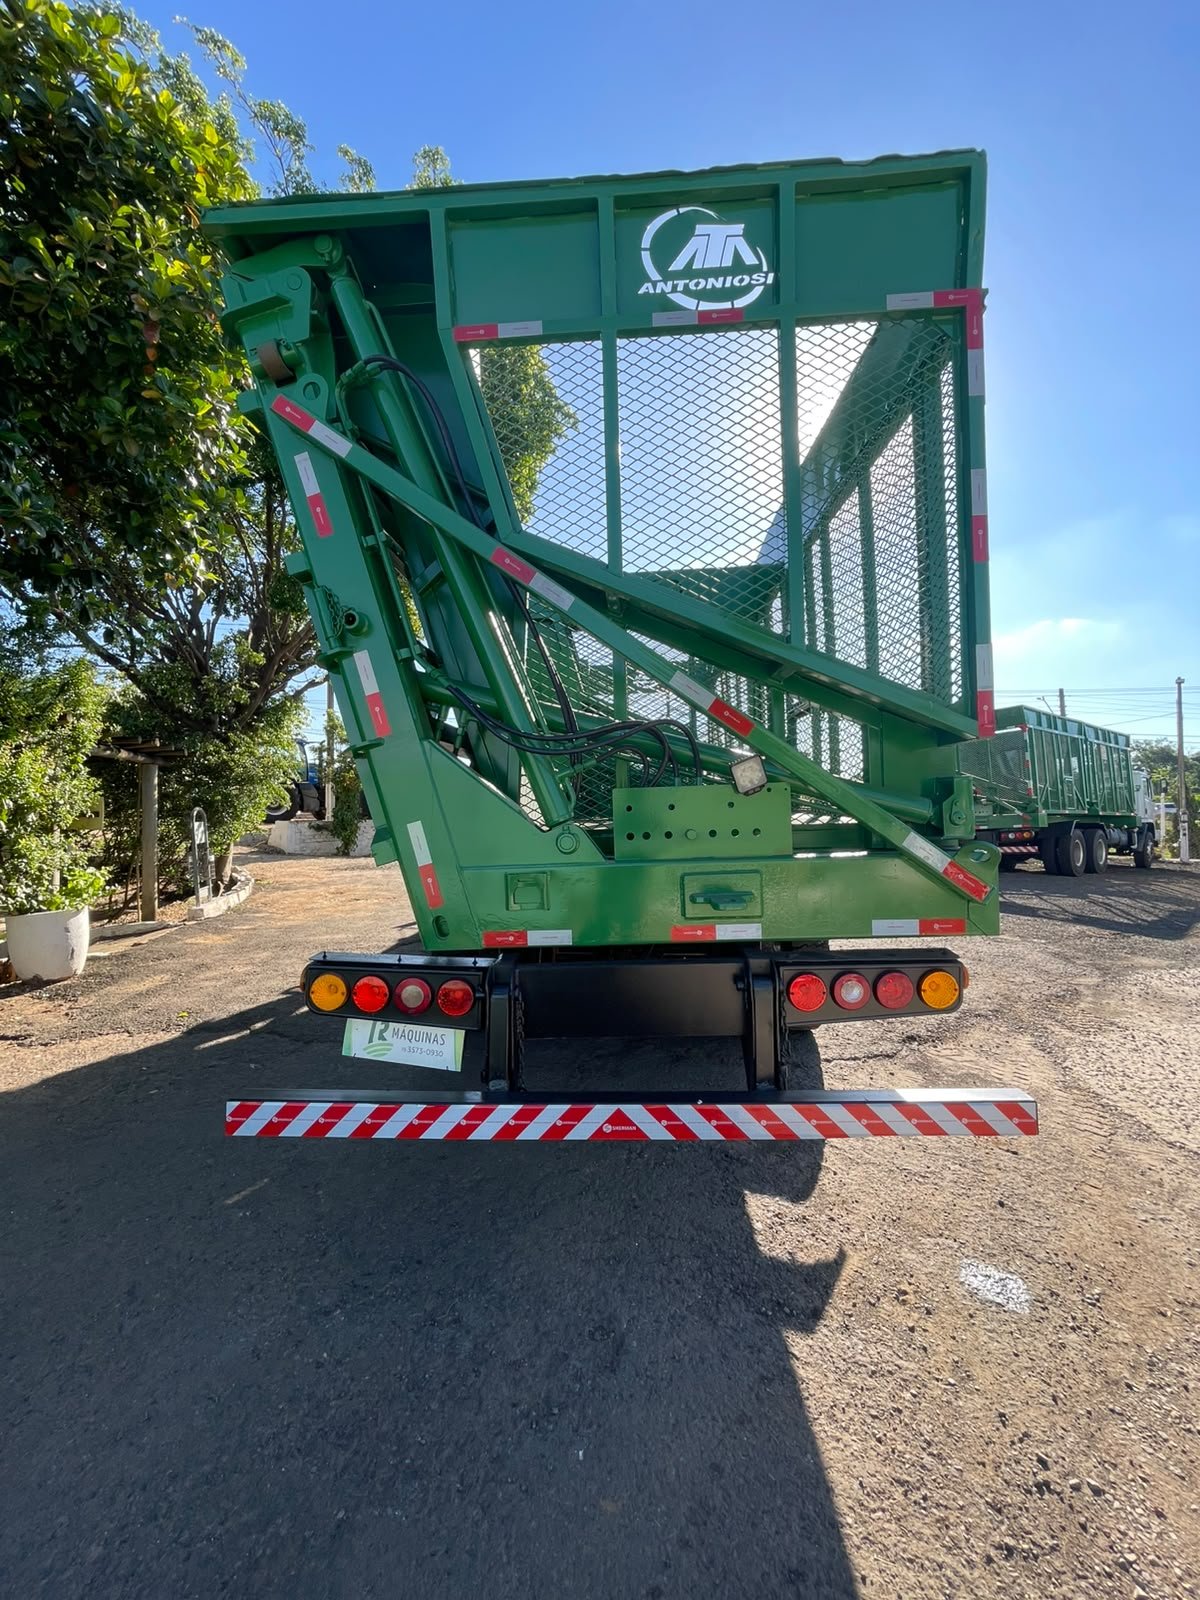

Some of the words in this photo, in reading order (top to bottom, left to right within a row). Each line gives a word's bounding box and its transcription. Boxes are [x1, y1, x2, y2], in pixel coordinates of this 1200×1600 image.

[637, 272, 775, 294] ANTONIOSI
[391, 1025, 447, 1046] MÁQUINAS
[407, 1046, 444, 1057] 3573-0930
